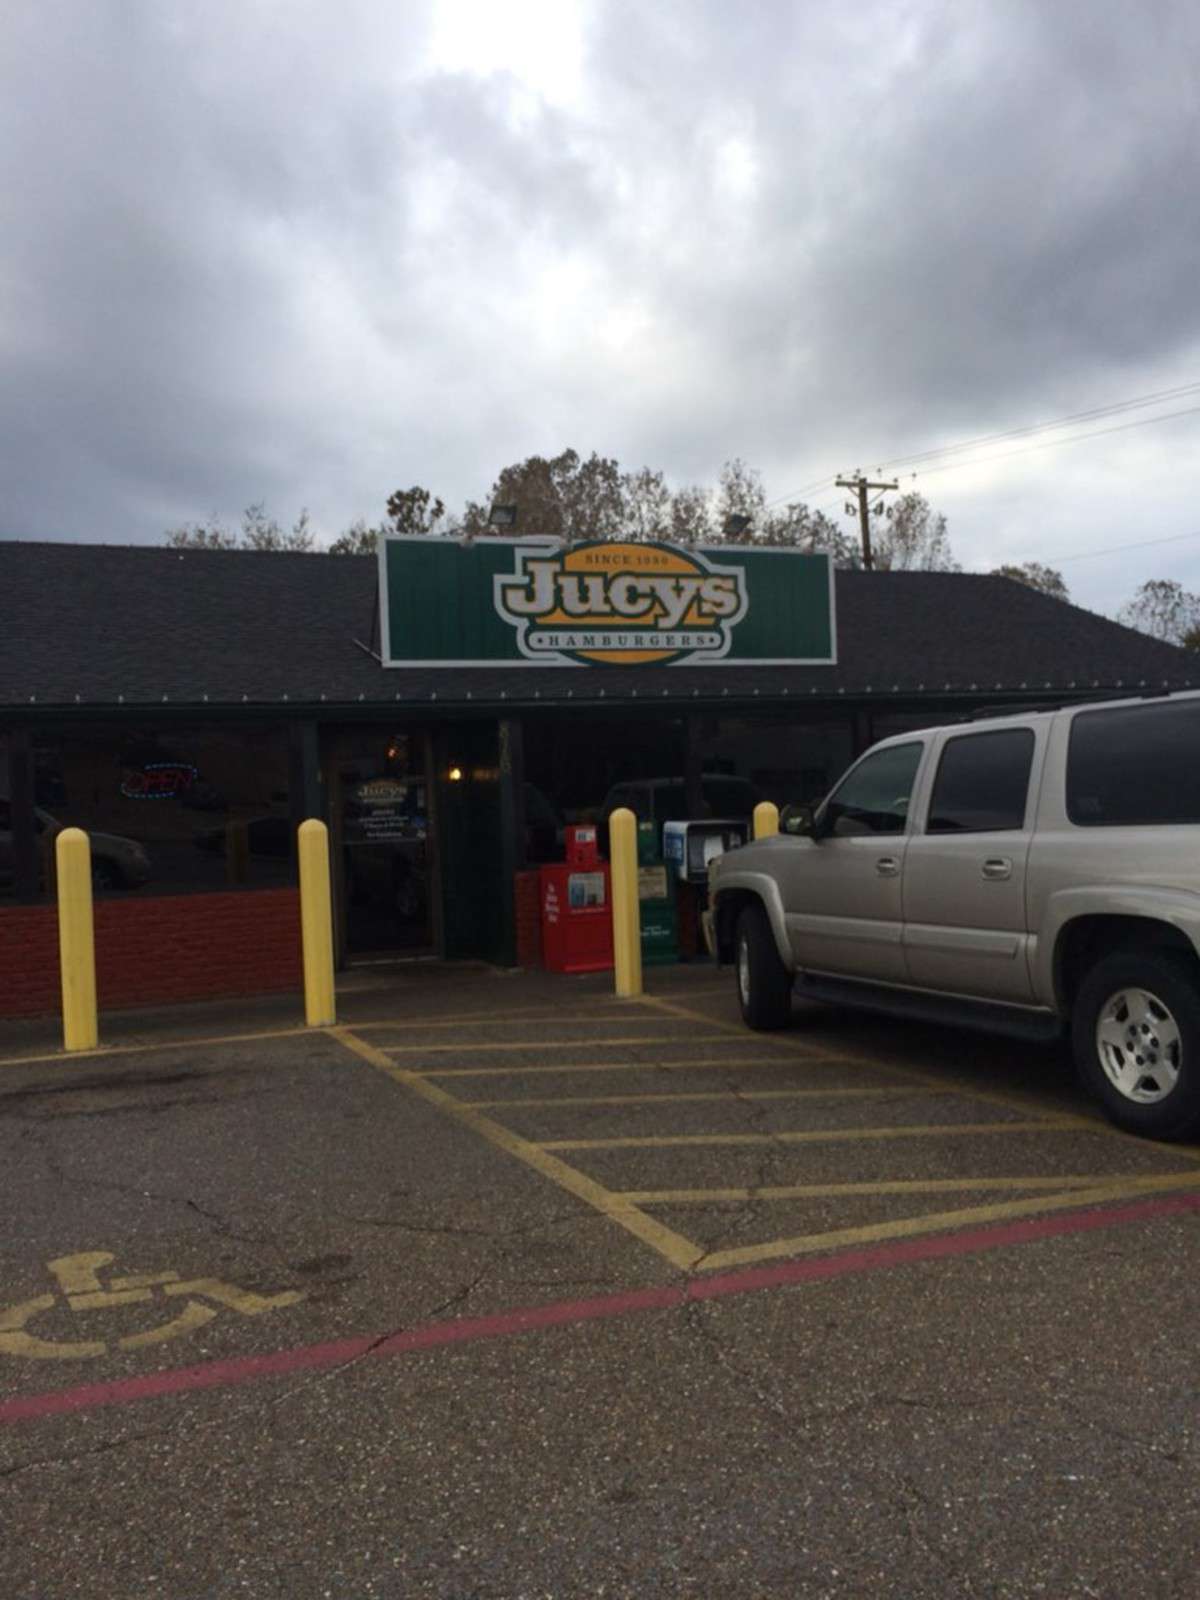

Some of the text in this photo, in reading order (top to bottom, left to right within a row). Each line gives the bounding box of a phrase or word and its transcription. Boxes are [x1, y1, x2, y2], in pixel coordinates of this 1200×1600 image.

[585, 553, 630, 565] SINCE
[506, 562, 739, 629] Jucys
[549, 636, 706, 647] HAMBURGERS
[127, 769, 193, 790] OPEN
